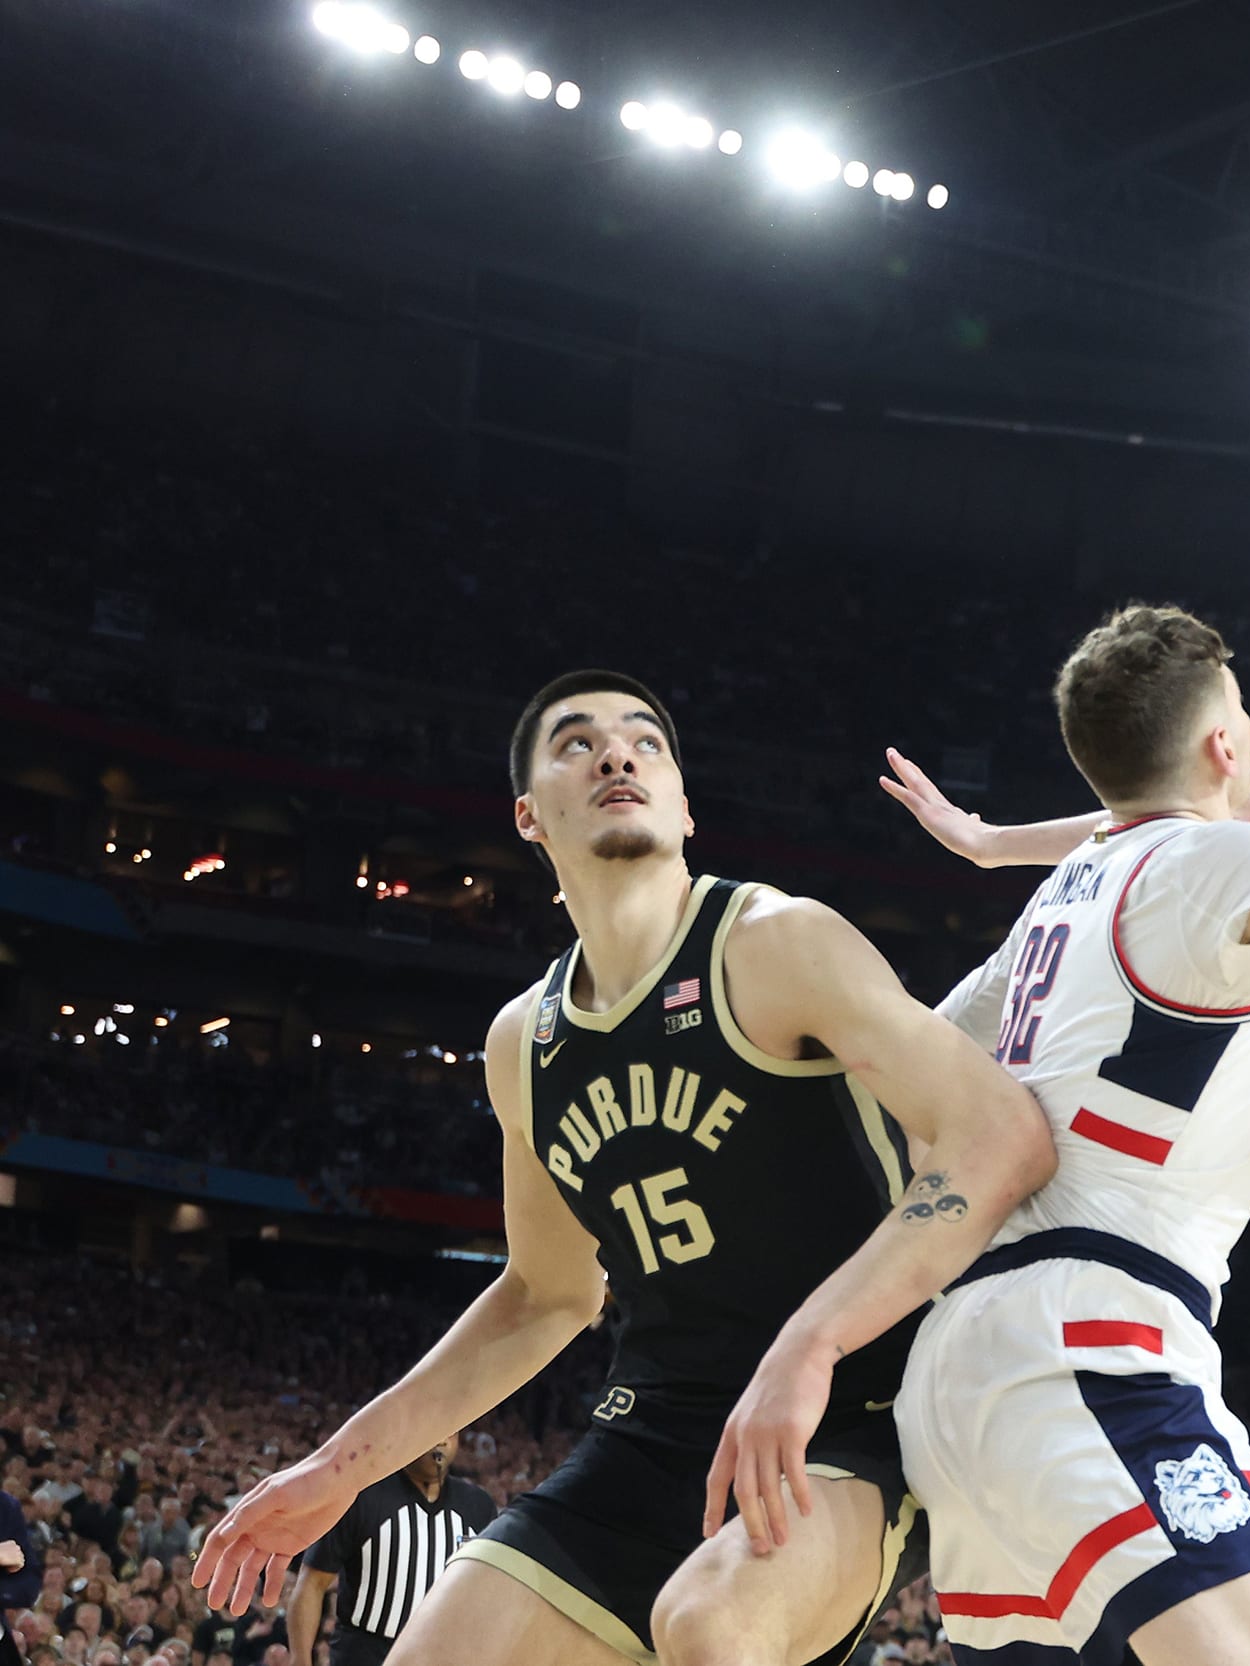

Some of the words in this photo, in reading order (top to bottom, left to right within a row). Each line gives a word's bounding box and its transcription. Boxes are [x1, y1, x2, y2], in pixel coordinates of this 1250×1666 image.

[995, 923, 1071, 1065] 32
[548, 1063, 748, 1192] PURDUE
[610, 1167, 716, 1275] 15
[593, 1386, 636, 1421] P
